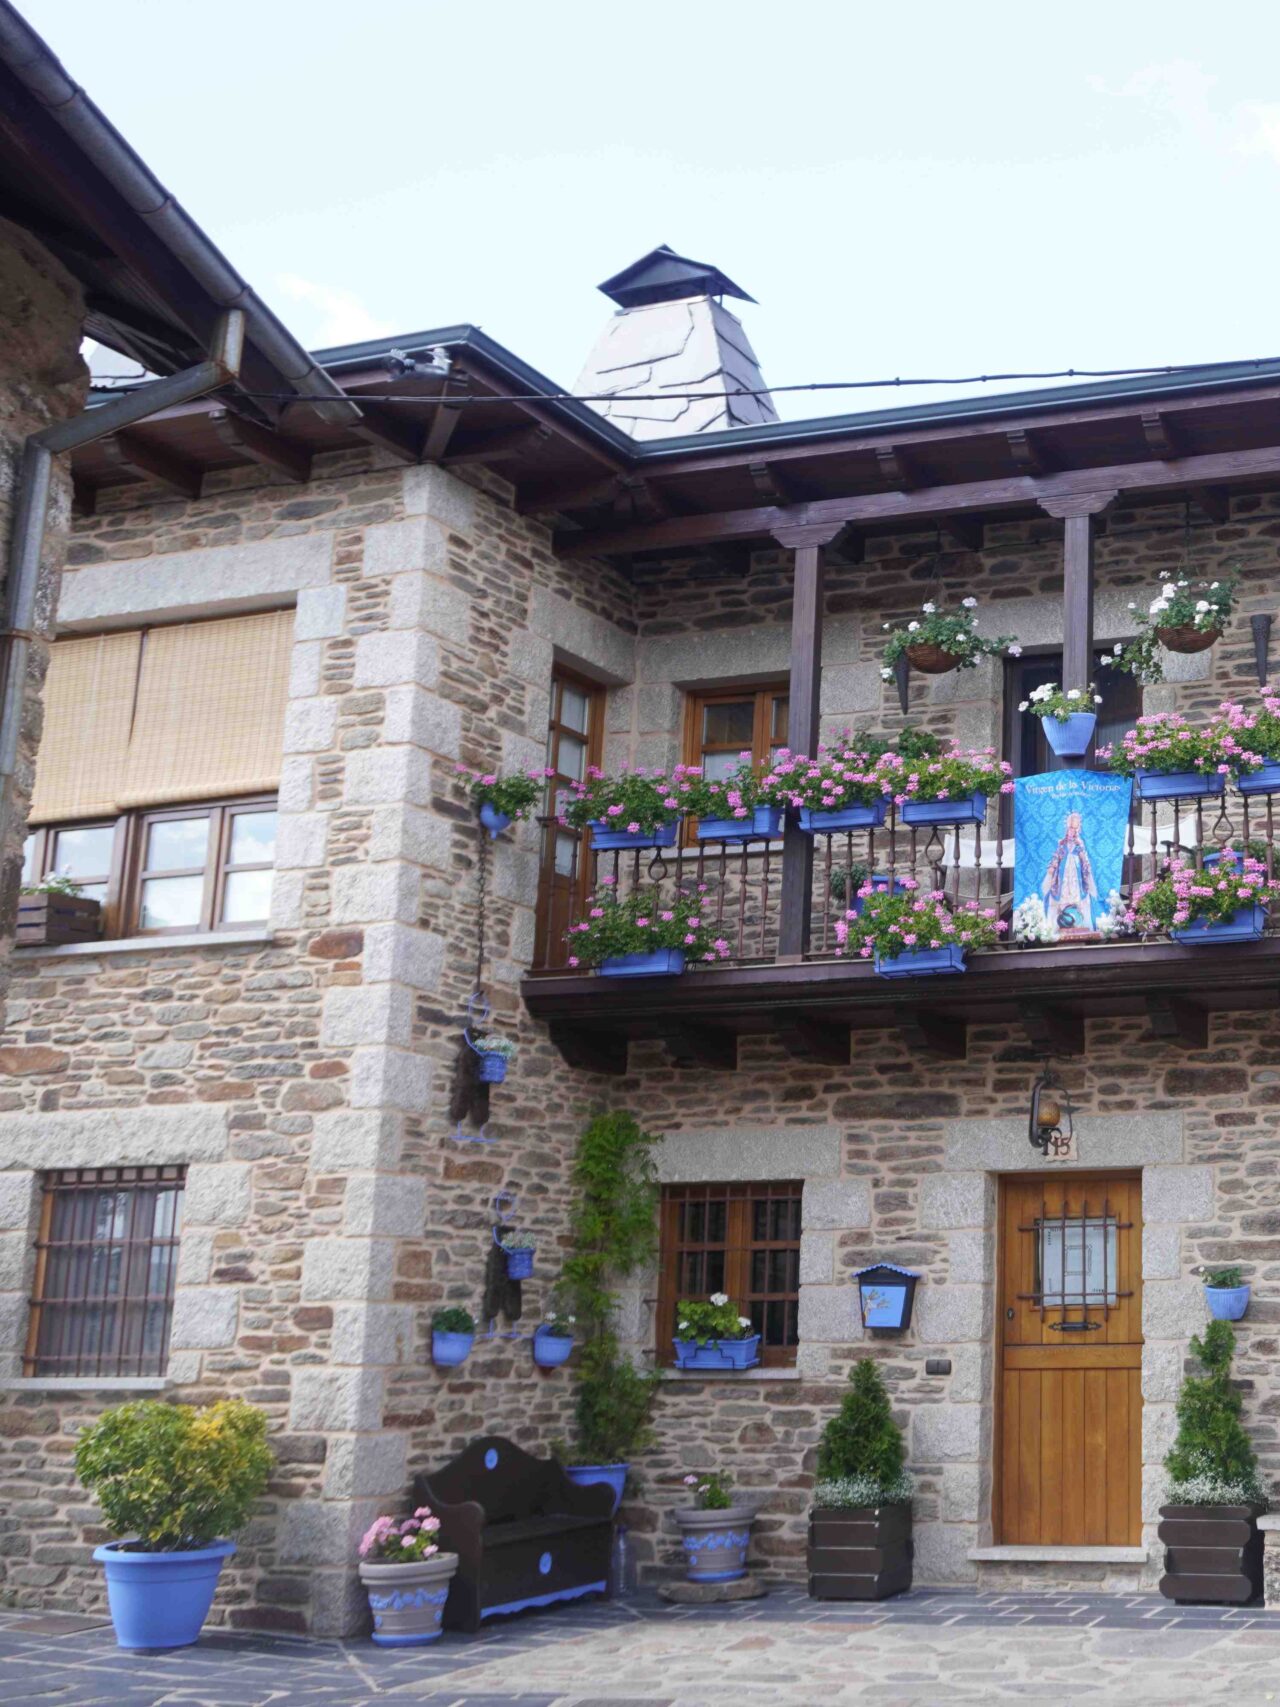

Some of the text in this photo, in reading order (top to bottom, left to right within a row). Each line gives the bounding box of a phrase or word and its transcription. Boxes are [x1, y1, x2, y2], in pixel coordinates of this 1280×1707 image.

[1025, 784, 1054, 794] Virgen
[1056, 781, 1064, 790] de
[1081, 780, 1121, 792] Victorias
